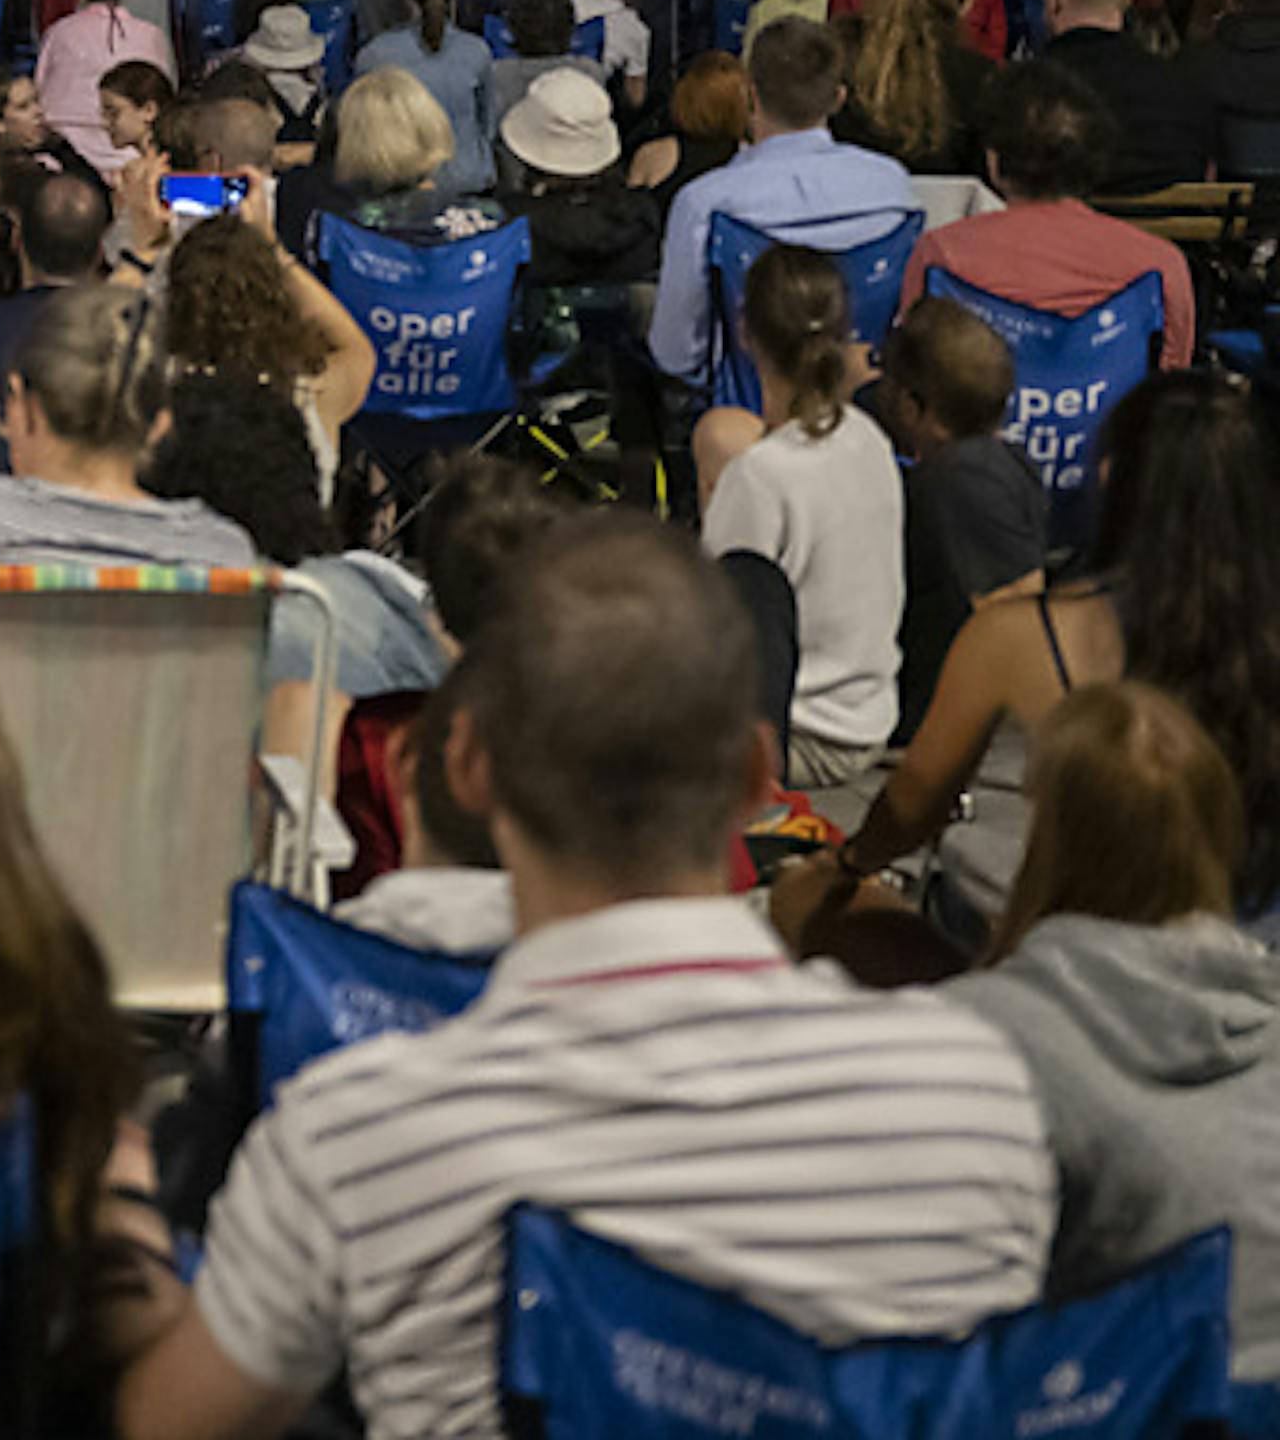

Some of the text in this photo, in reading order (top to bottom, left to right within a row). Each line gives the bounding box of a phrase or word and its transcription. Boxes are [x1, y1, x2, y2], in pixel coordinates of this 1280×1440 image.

[368, 305, 476, 345] oper
[383, 338, 458, 369] für
[375, 368, 462, 396] alle
[1008, 379, 1109, 423] per
[1041, 463, 1085, 490] le
